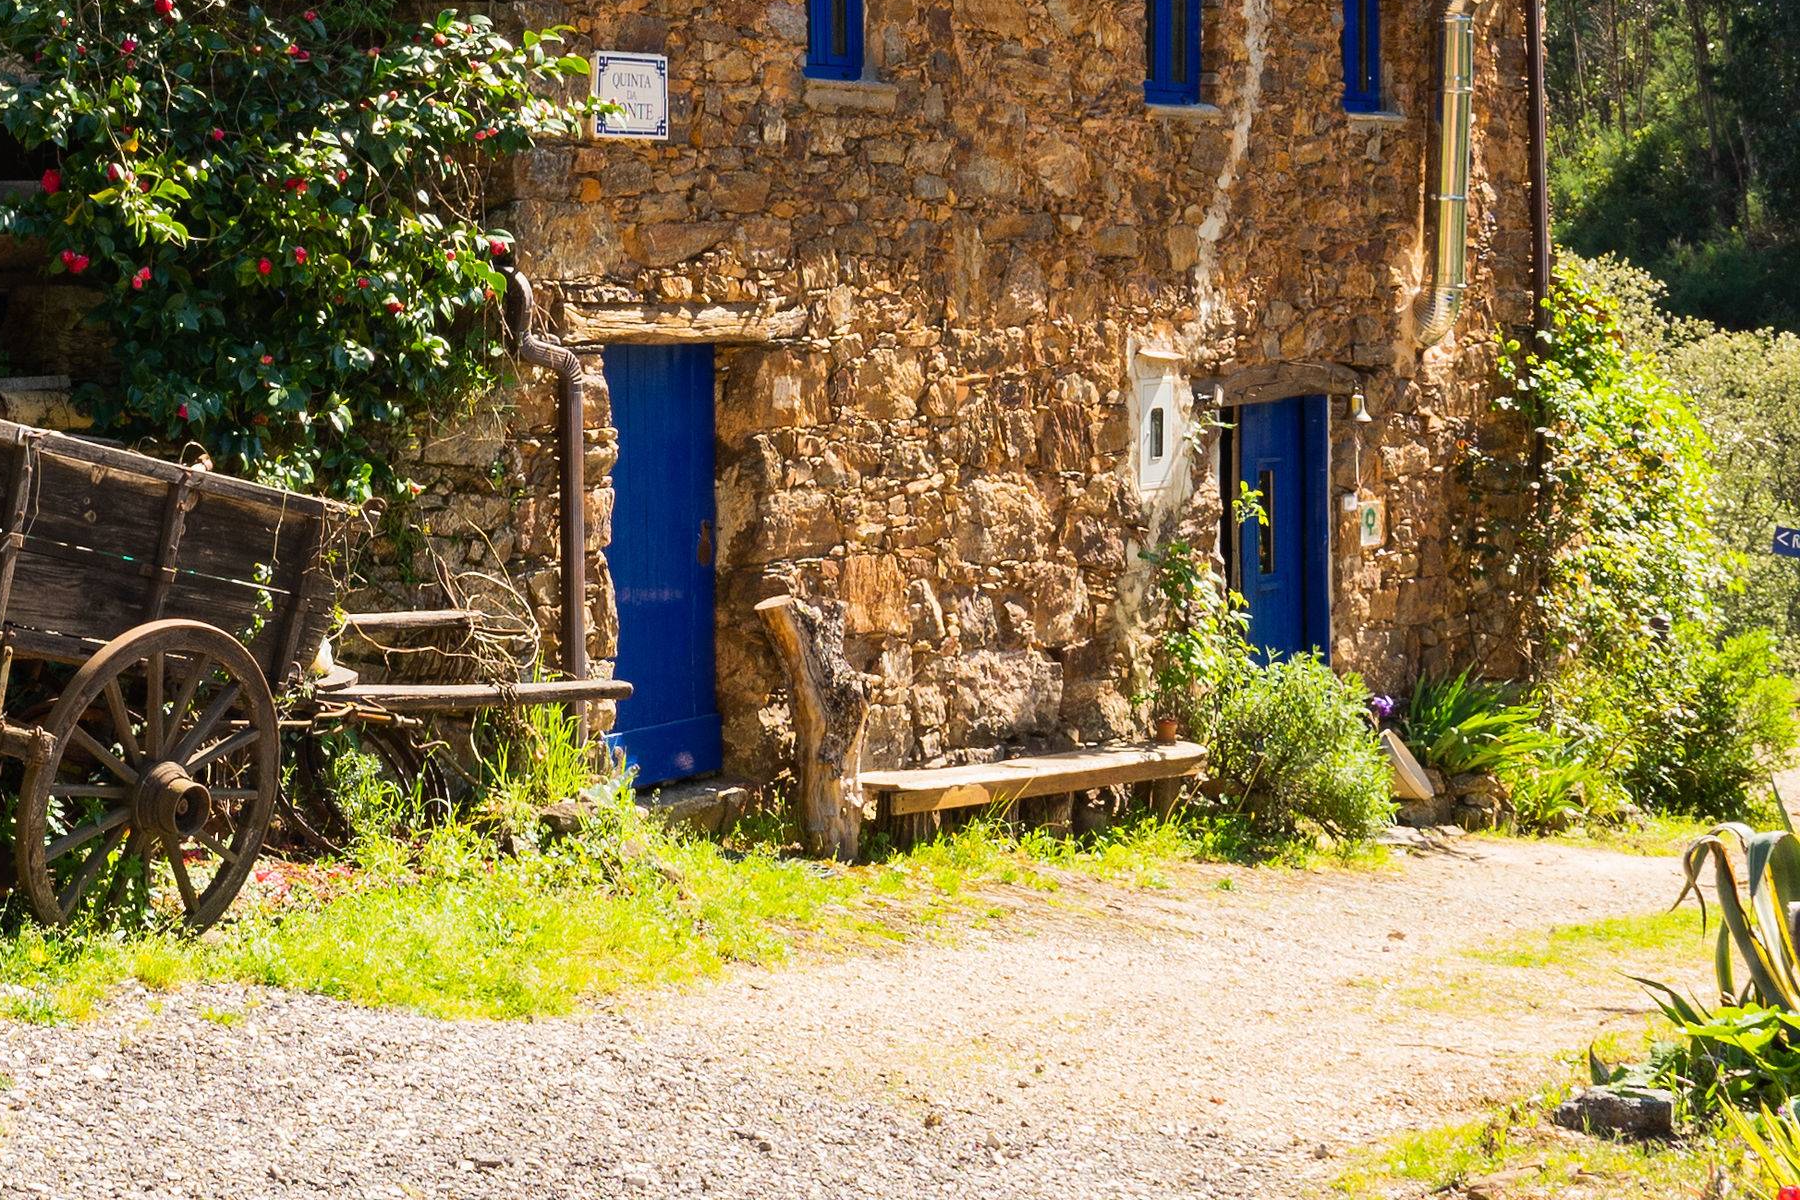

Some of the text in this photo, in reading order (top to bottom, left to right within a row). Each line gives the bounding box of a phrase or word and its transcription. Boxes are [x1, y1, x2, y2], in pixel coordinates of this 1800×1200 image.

[611, 72, 652, 89] QUINTA
[626, 90, 638, 101] DA
[611, 102, 655, 120] ONTE
